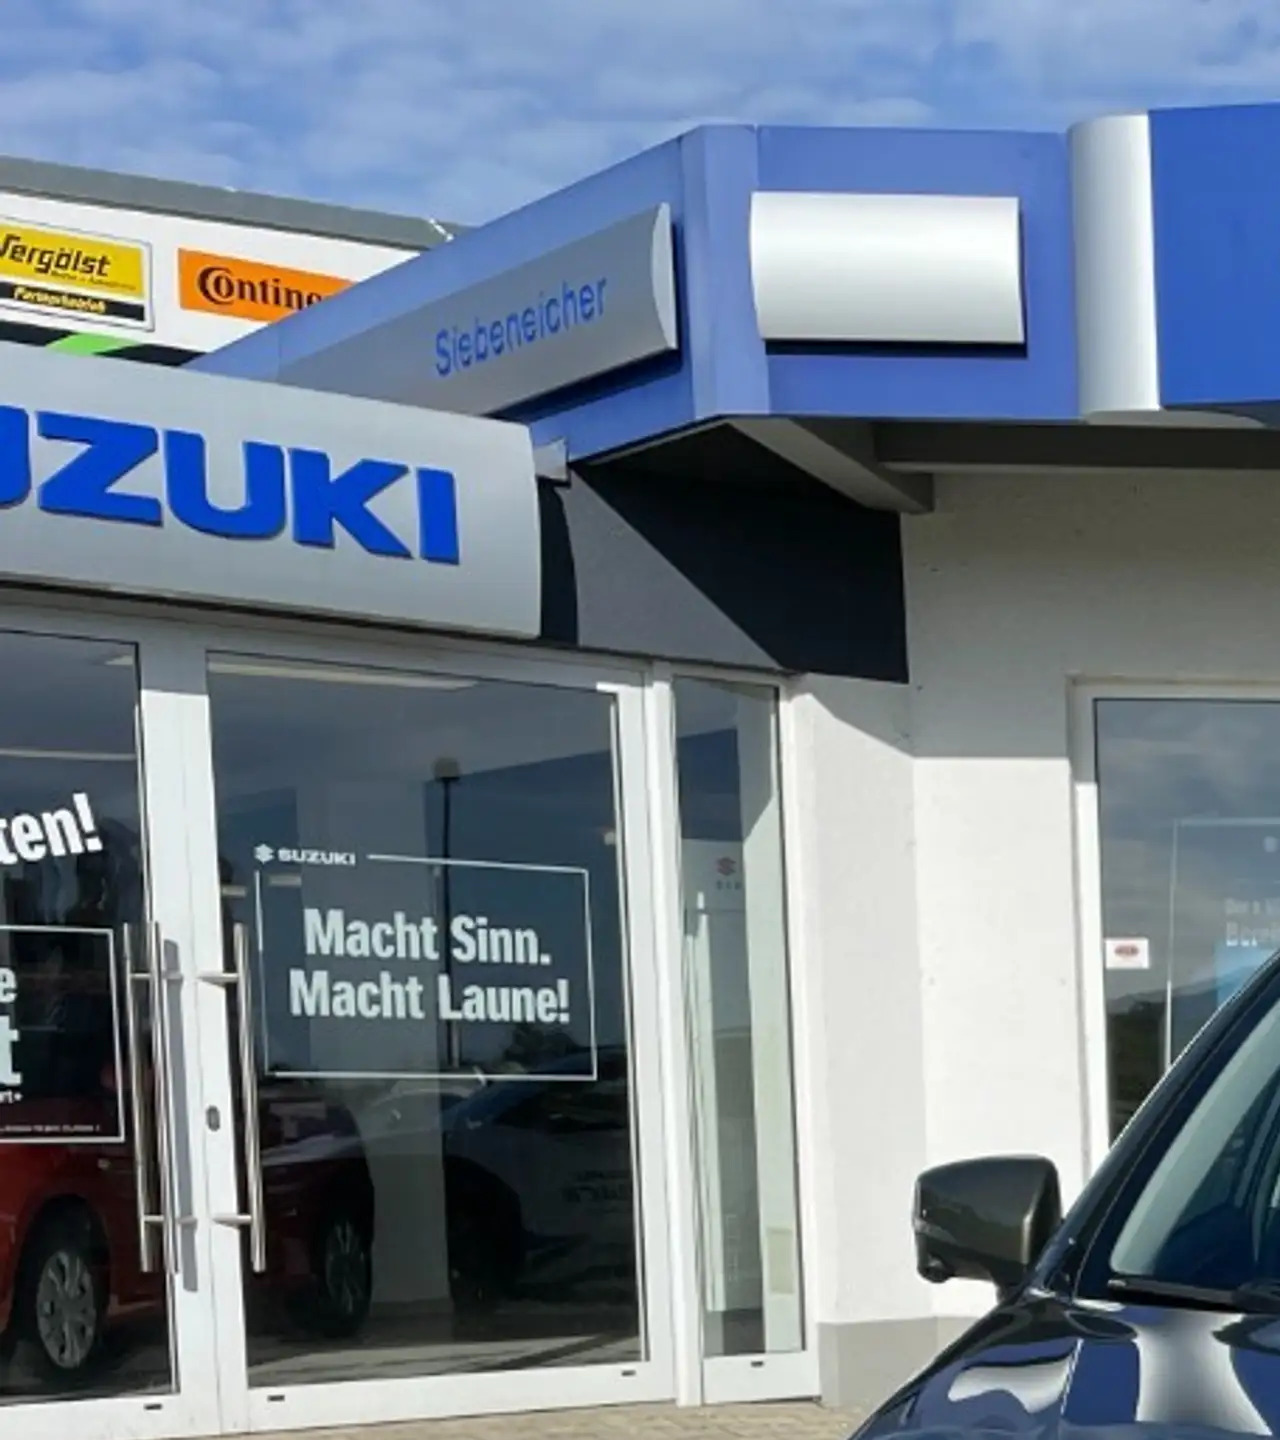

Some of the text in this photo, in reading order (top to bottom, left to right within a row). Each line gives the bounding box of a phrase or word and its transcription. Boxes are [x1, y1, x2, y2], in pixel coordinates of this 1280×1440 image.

[434, 277, 608, 378] Siebeneicher
[0, 404, 461, 566] ZUKI
[278, 847, 356, 867] SUZUKI
[303, 906, 552, 966] Macht Sinn.
[288, 966, 571, 1024] Macht Laune!
